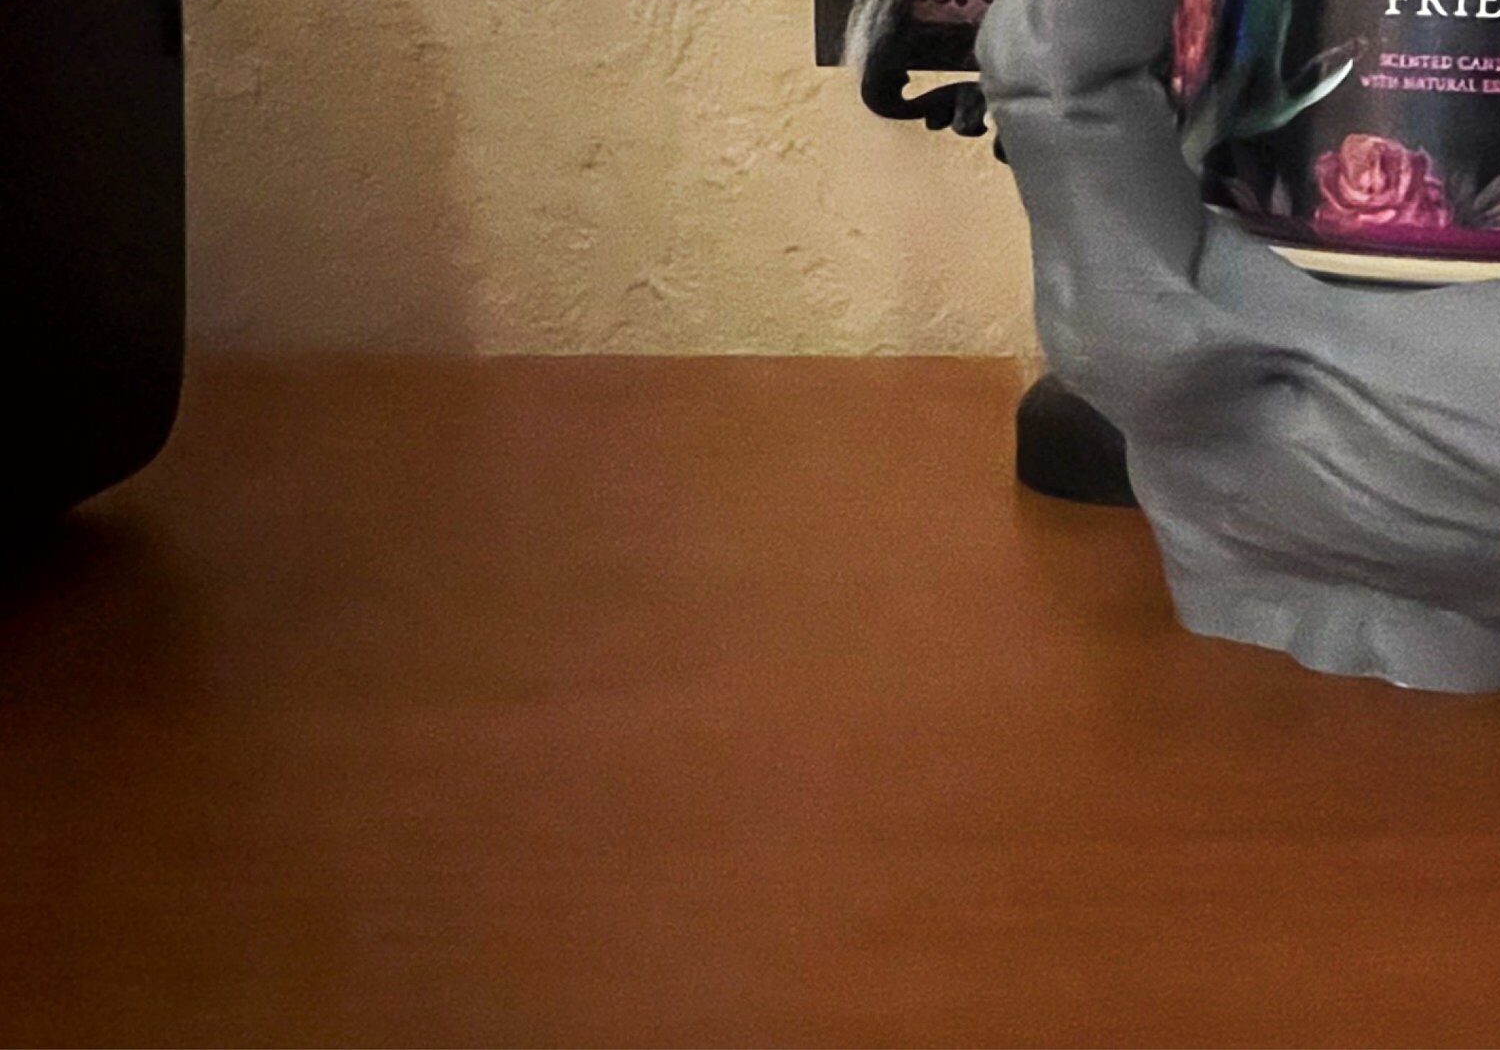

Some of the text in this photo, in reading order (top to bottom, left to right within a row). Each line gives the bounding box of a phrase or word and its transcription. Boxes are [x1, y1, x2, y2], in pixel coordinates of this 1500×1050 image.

[1379, 52, 1452, 70] SCENTED
[1359, 72, 1399, 90] WITH
[1402, 74, 1477, 93] NATURAL
